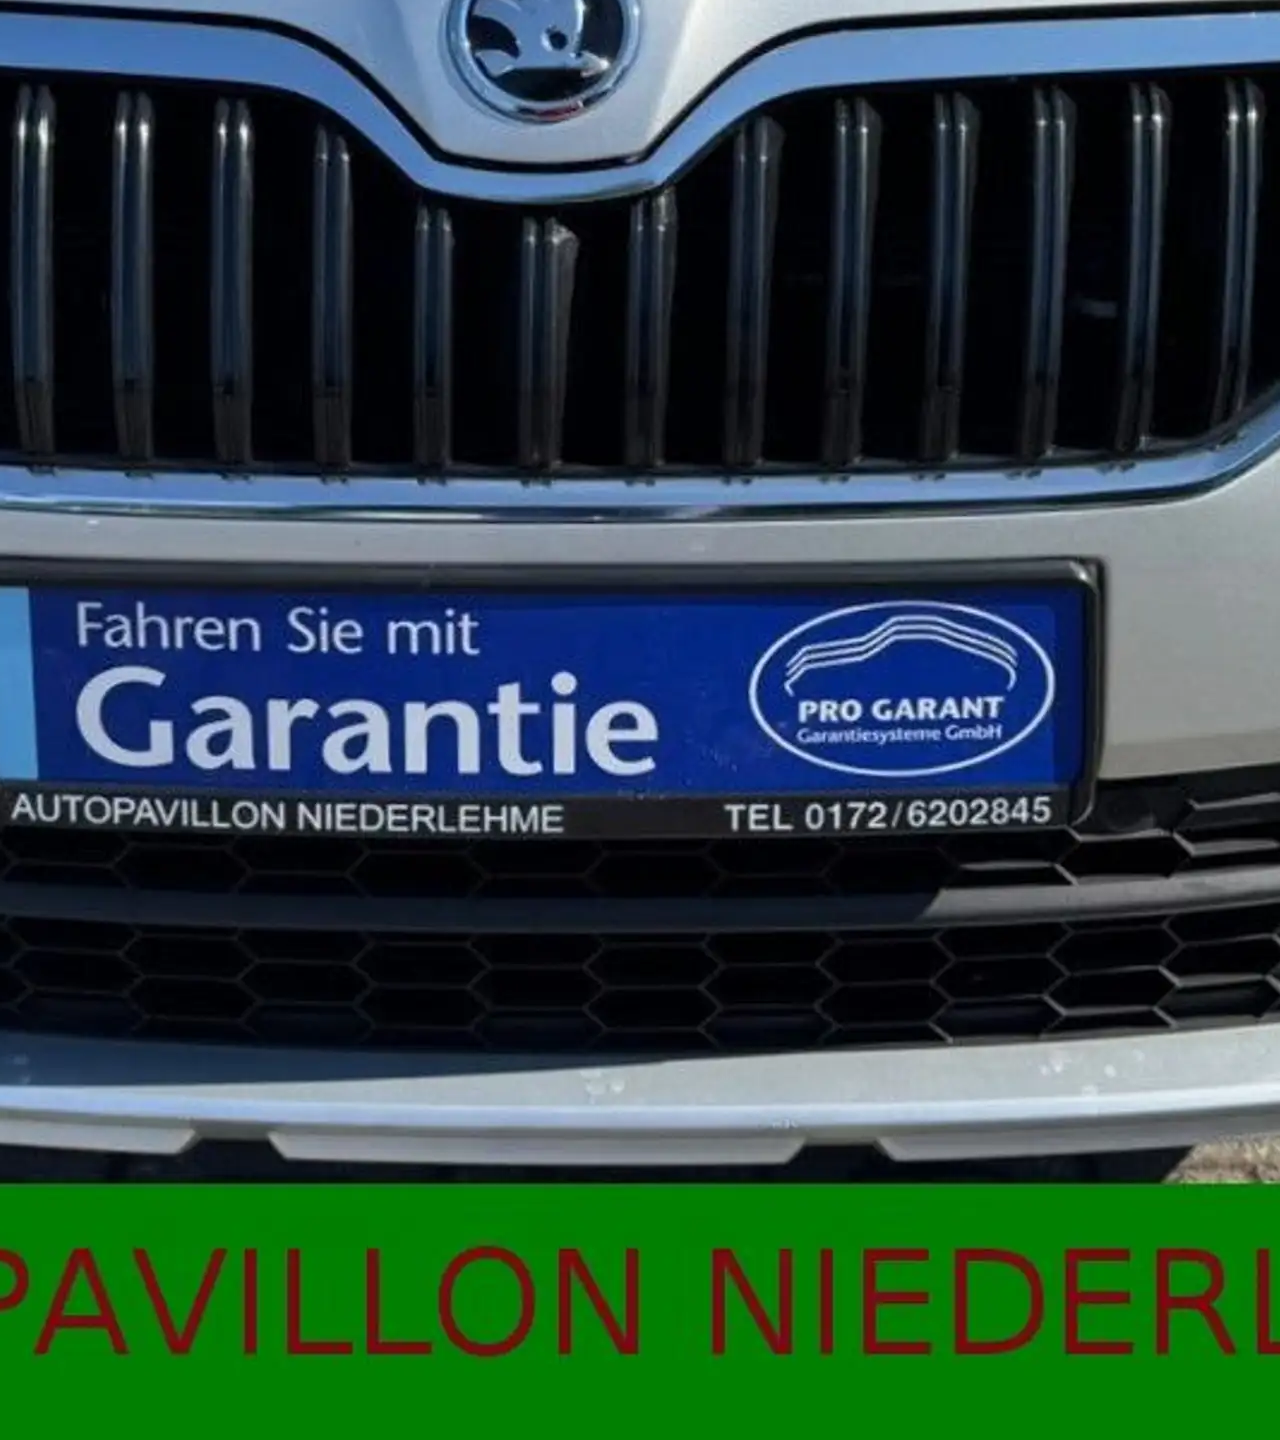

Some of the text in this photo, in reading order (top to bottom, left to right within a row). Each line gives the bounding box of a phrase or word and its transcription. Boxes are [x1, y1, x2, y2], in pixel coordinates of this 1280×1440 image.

[77, 602, 480, 655] Fahren Sie mit
[76, 665, 659, 776] Garantie
[798, 695, 1006, 724] PRO GARANT
[796, 724, 1002, 747] Garantiesysteme GmbH
[11, 793, 565, 834] AUTOPAVILLON NIEDERLEHME
[724, 795, 1052, 832] TEL 0172/6202845
